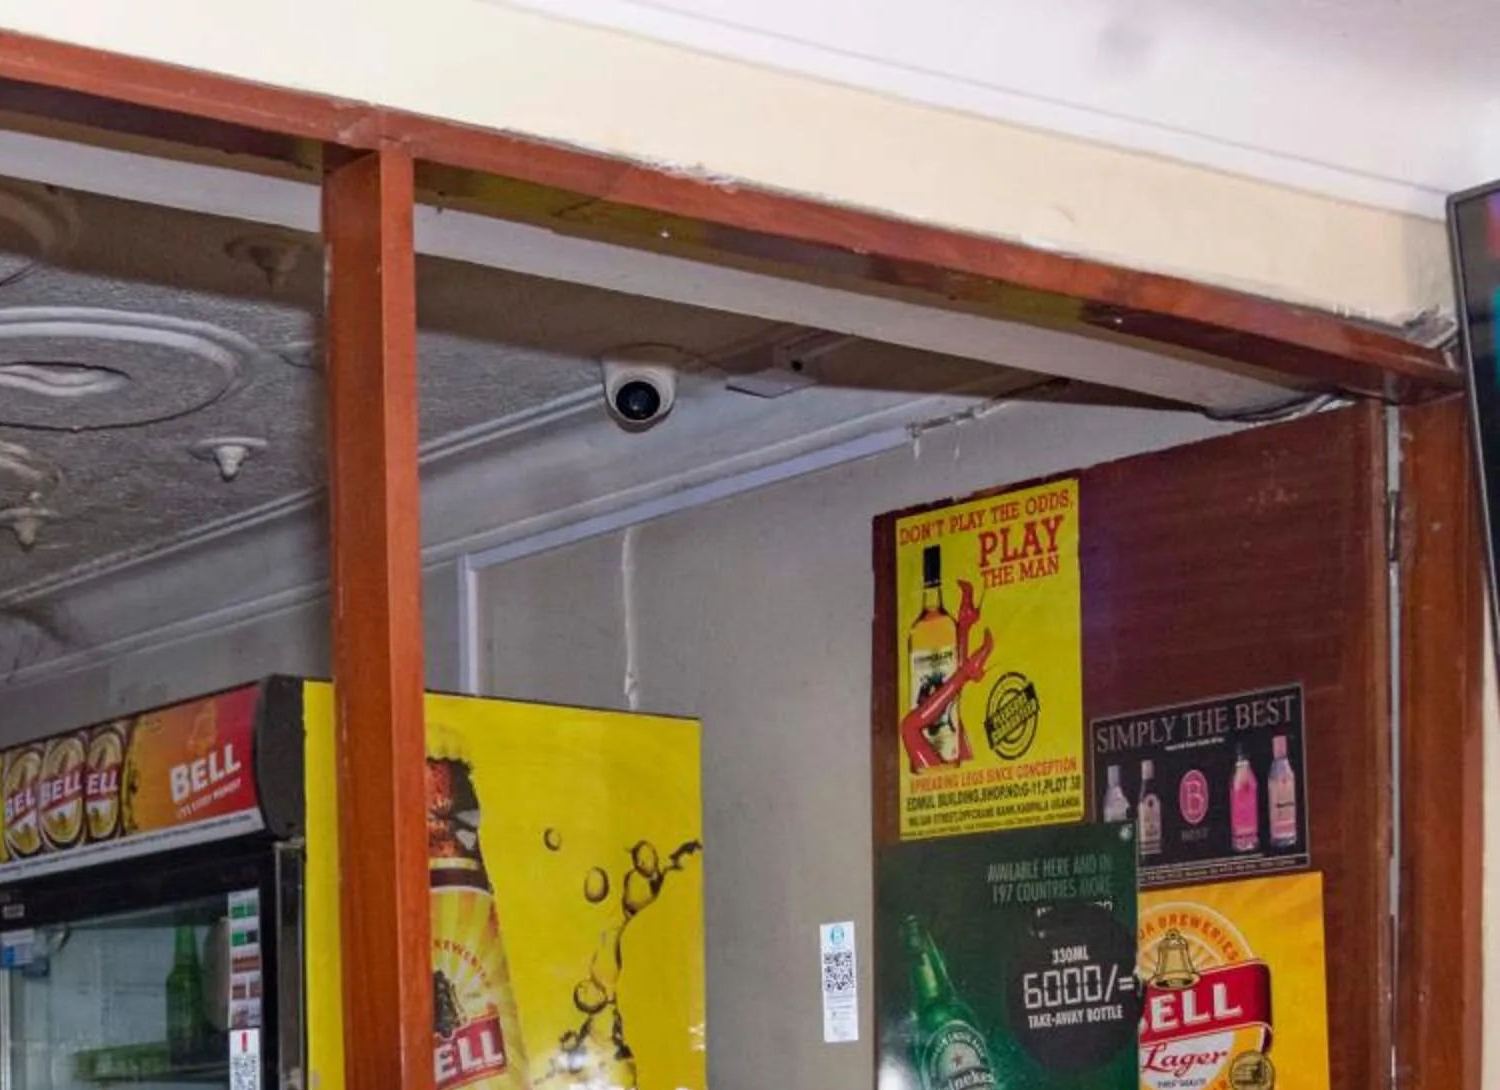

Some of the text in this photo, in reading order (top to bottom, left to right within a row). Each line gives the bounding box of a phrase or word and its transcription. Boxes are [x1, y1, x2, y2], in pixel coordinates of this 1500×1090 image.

[899, 519, 944, 546] DON'T
[949, 509, 986, 534] PLAY
[991, 501, 1021, 524] THE
[978, 514, 1064, 568] PLAY
[981, 555, 1060, 590] THE MAN
[1096, 695, 1297, 754] SIMPLY THE BEST
[86, 769, 118, 795] ELL
[169, 743, 241, 805] BELL
[988, 853, 1113, 883] AVAILABLE HERE AND IN
[1016, 878, 1078, 903] COUNTRIES
[1052, 944, 1090, 965] 330ML
[1157, 911, 1240, 962] BREWERIES
[1023, 963, 1135, 1010] 6000/=
[1027, 1004, 1124, 1030] TAKE-AWAY BOTTLE
[434, 1030, 504, 1084] ELL
[1142, 1041, 1228, 1079] Lager
